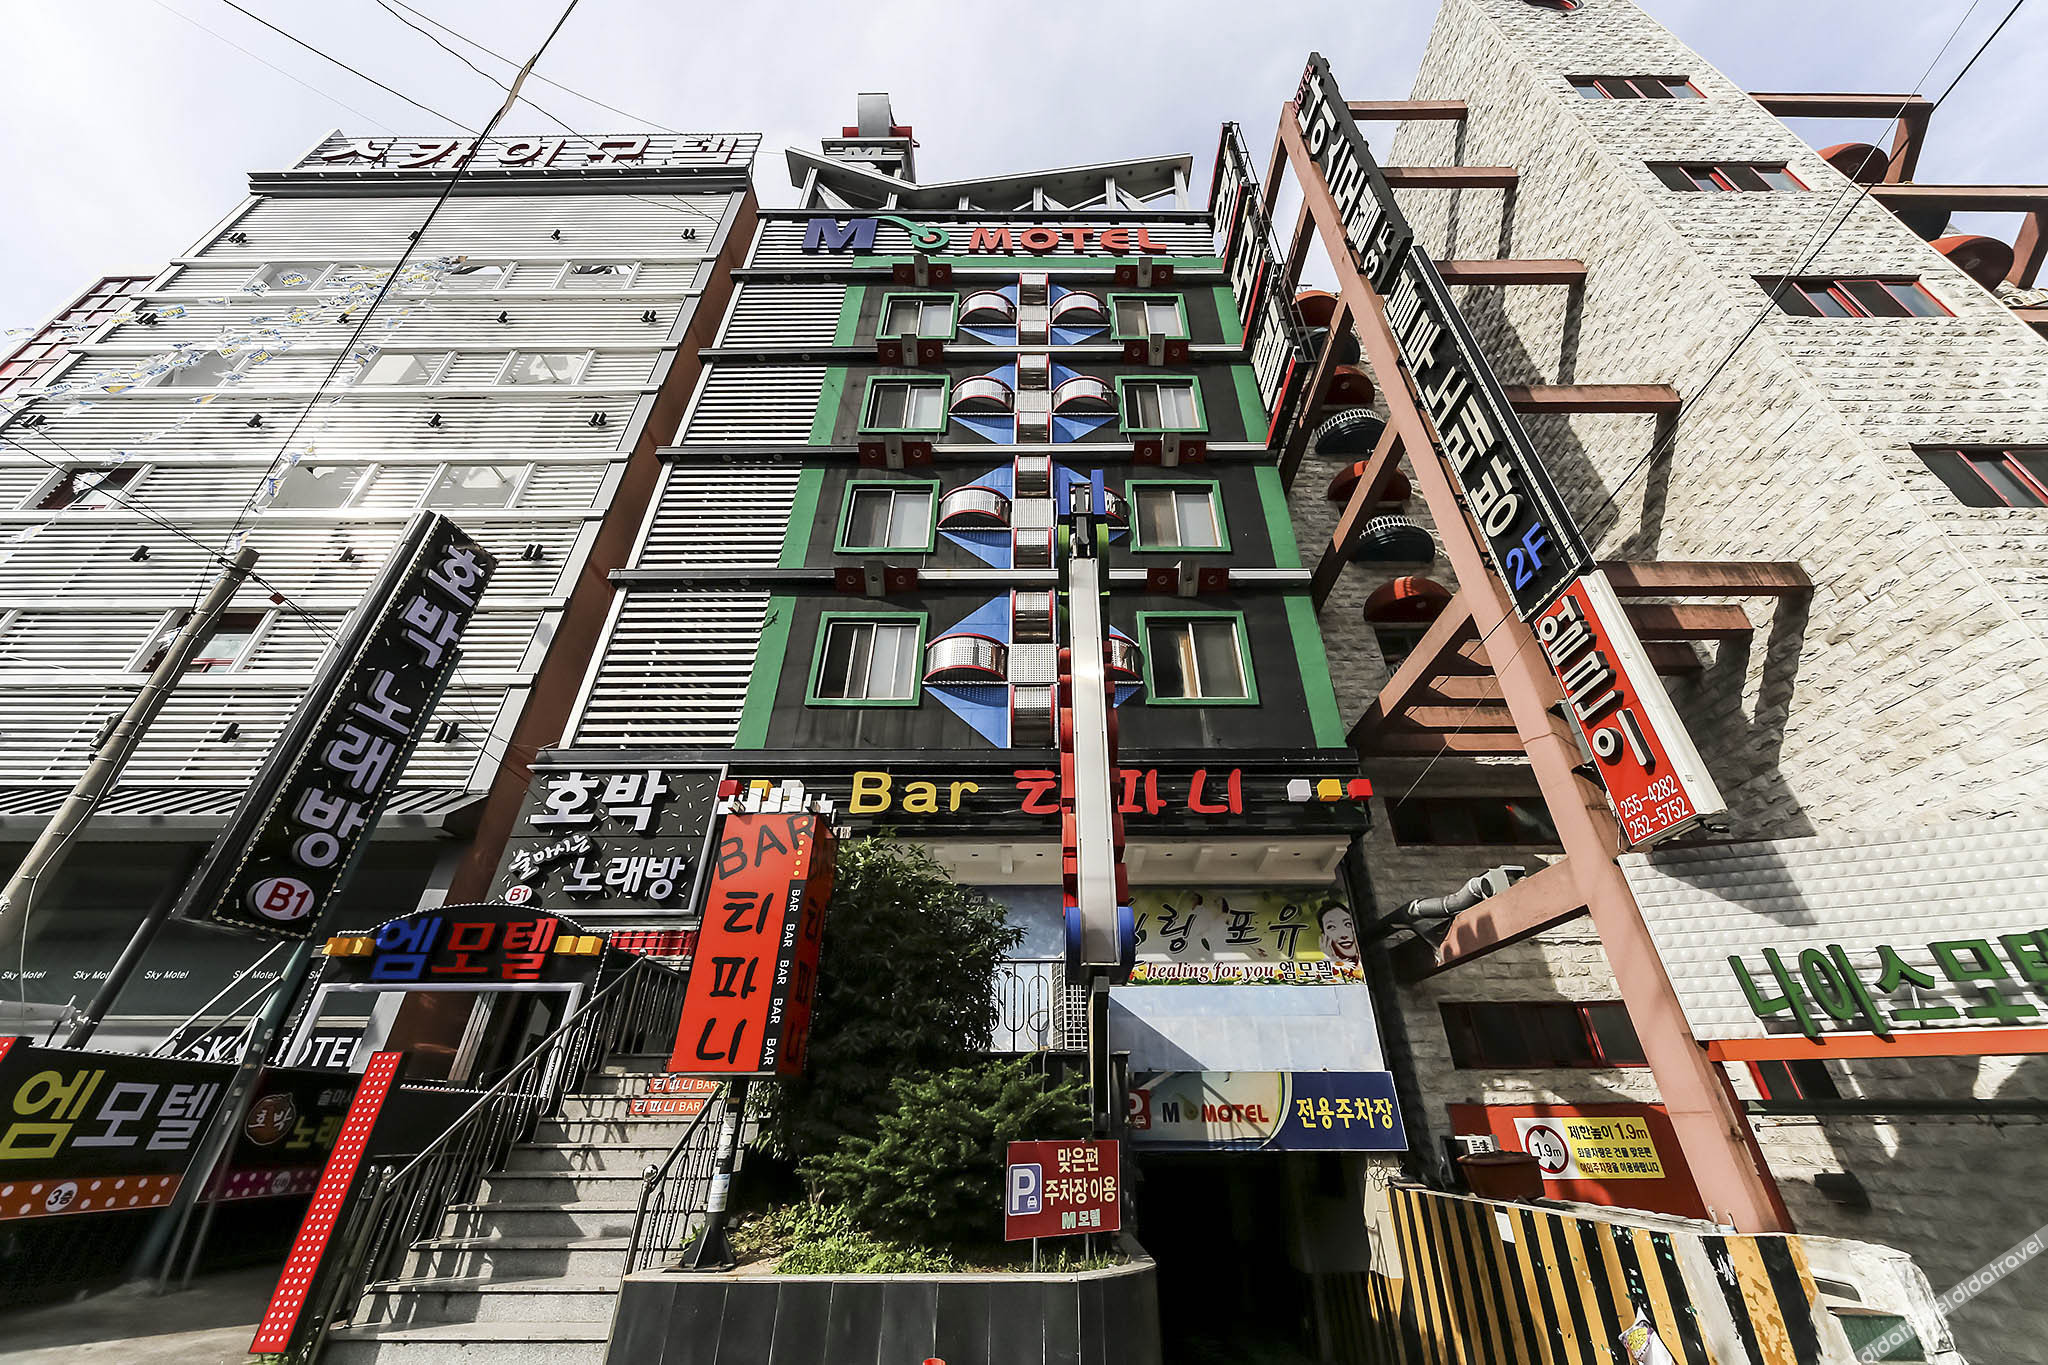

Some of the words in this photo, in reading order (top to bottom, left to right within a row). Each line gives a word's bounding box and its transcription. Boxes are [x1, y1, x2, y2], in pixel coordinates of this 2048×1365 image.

[320, 137, 740, 169] 스카이모텔
[1297, 74, 1382, 255] 나이스모텔
[968, 226, 1168, 255] MOTEL
[1386, 269, 1443, 377] 블루
[1424, 366, 1519, 538] 노래방
[1505, 521, 1547, 591] 2F
[405, 543, 485, 670] 호박
[1539, 594, 1648, 767] 얼큰이
[297, 670, 412, 868] 노래방
[529, 770, 668, 831] 호박
[848, 770, 979, 815] Bar
[1619, 773, 1679, 819] 255-4282
[1628, 796, 1690, 841] 252-5752
[508, 833, 592, 881] 술마시는
[716, 814, 815, 880] BAR
[562, 856, 686, 900] 노래방
[264, 880, 312, 919] B1
[508, 887, 530, 903] B1
[788, 888, 802, 913] BAR
[369, 916, 559, 980] 엠모텔
[782, 923, 796, 948] BAR
[1, 970, 20, 982] Sky
[22, 970, 47, 980] Motel
[73, 970, 91, 981] Sky
[144, 970, 162, 981] Sky
[163, 970, 190, 980] Motel
[251, 970, 278, 980] Motel
[776, 959, 790, 985] BAR
[1146, 962, 1209, 982] healing
[1244, 967, 1274, 982] you
[1279, 960, 1332, 981] 엠모텔
[769, 997, 784, 1024] BAR
[762, 1037, 778, 1066] BAR
[696, 1080, 719, 1090] BAR
[0, 1068, 220, 1160] 엠모텔
[247, 1107, 293, 1132] 호박
[678, 1101, 701, 1112] BAR
[1201, 1103, 1270, 1124] MOTEL
[1295, 1096, 1394, 1130] 전용주차장
[1567, 1125, 1614, 1140] 제한높이
[1614, 1122, 1649, 1140] 1.9m
[1057, 1146, 1099, 1174] 맞은편
[1534, 1141, 1562, 1158] 1.9m
[1044, 1177, 1088, 1206] 주차장
[1090, 1175, 1117, 1203] 이용
[1061, 1211, 1077, 1230] M
[1077, 1208, 1101, 1227] 모텔
